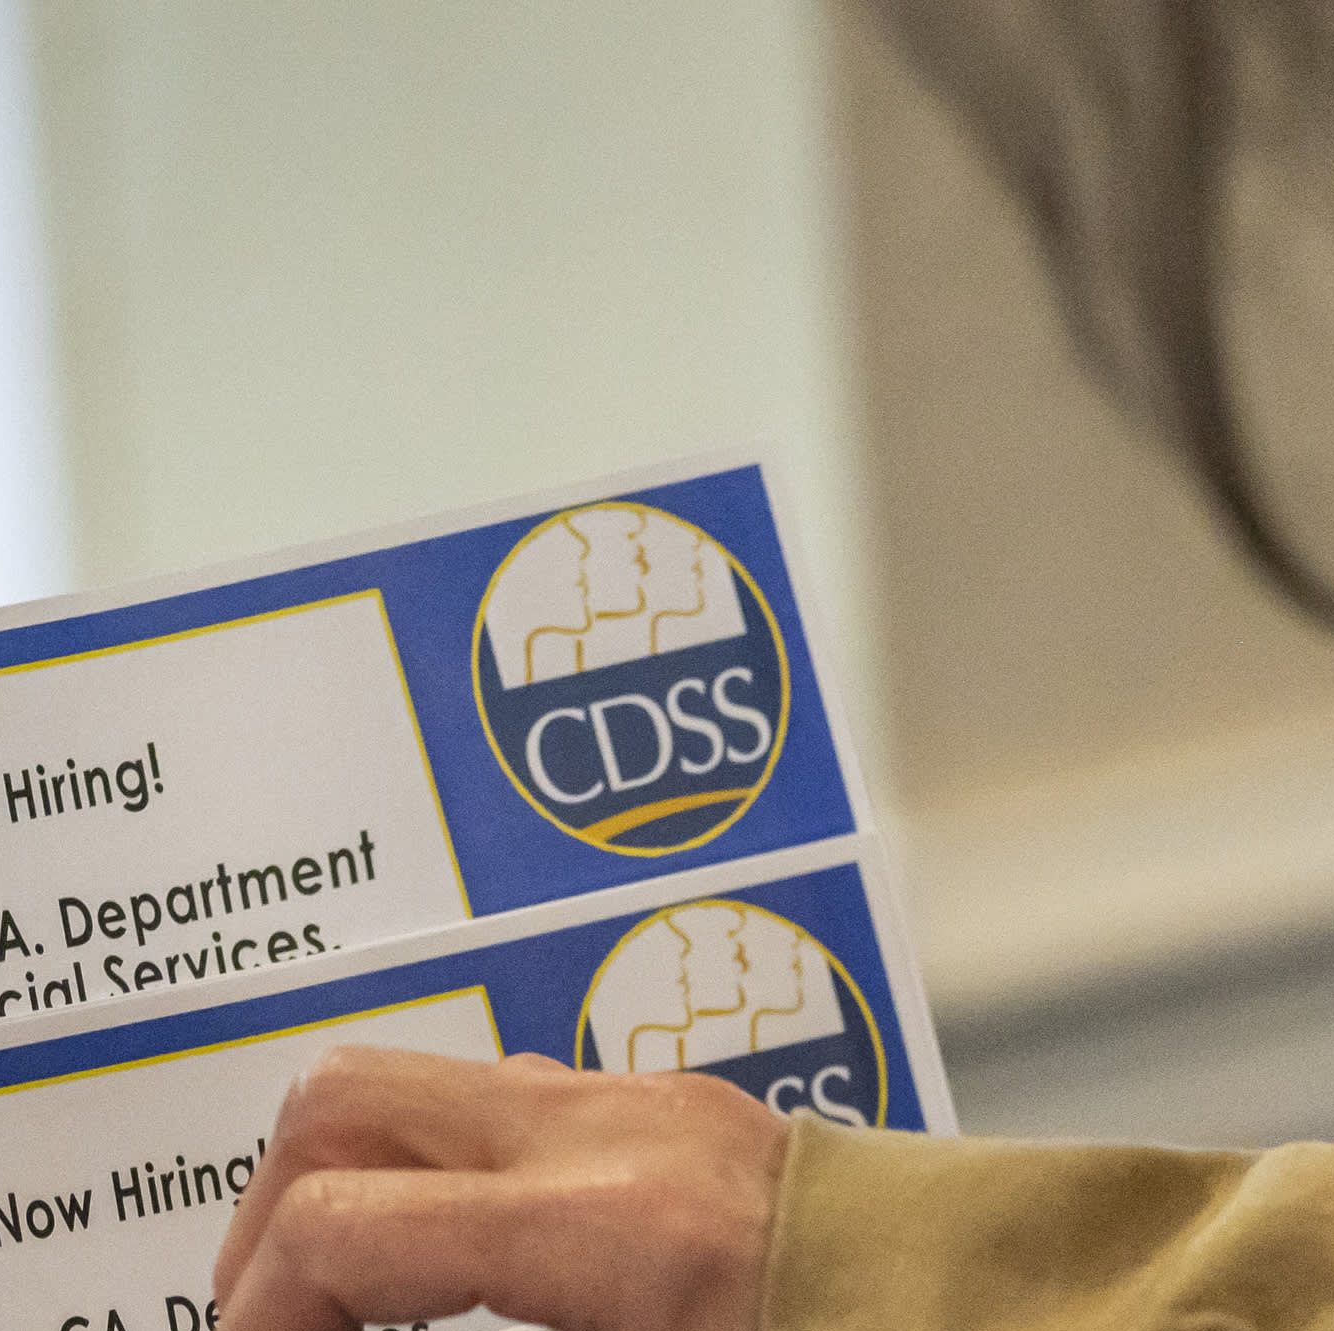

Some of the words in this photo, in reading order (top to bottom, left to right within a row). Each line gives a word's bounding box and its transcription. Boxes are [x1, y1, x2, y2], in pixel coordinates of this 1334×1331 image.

[3, 741, 165, 823] Hiring!
[524, 667, 770, 804] CDSS
[58, 830, 378, 948] Department
